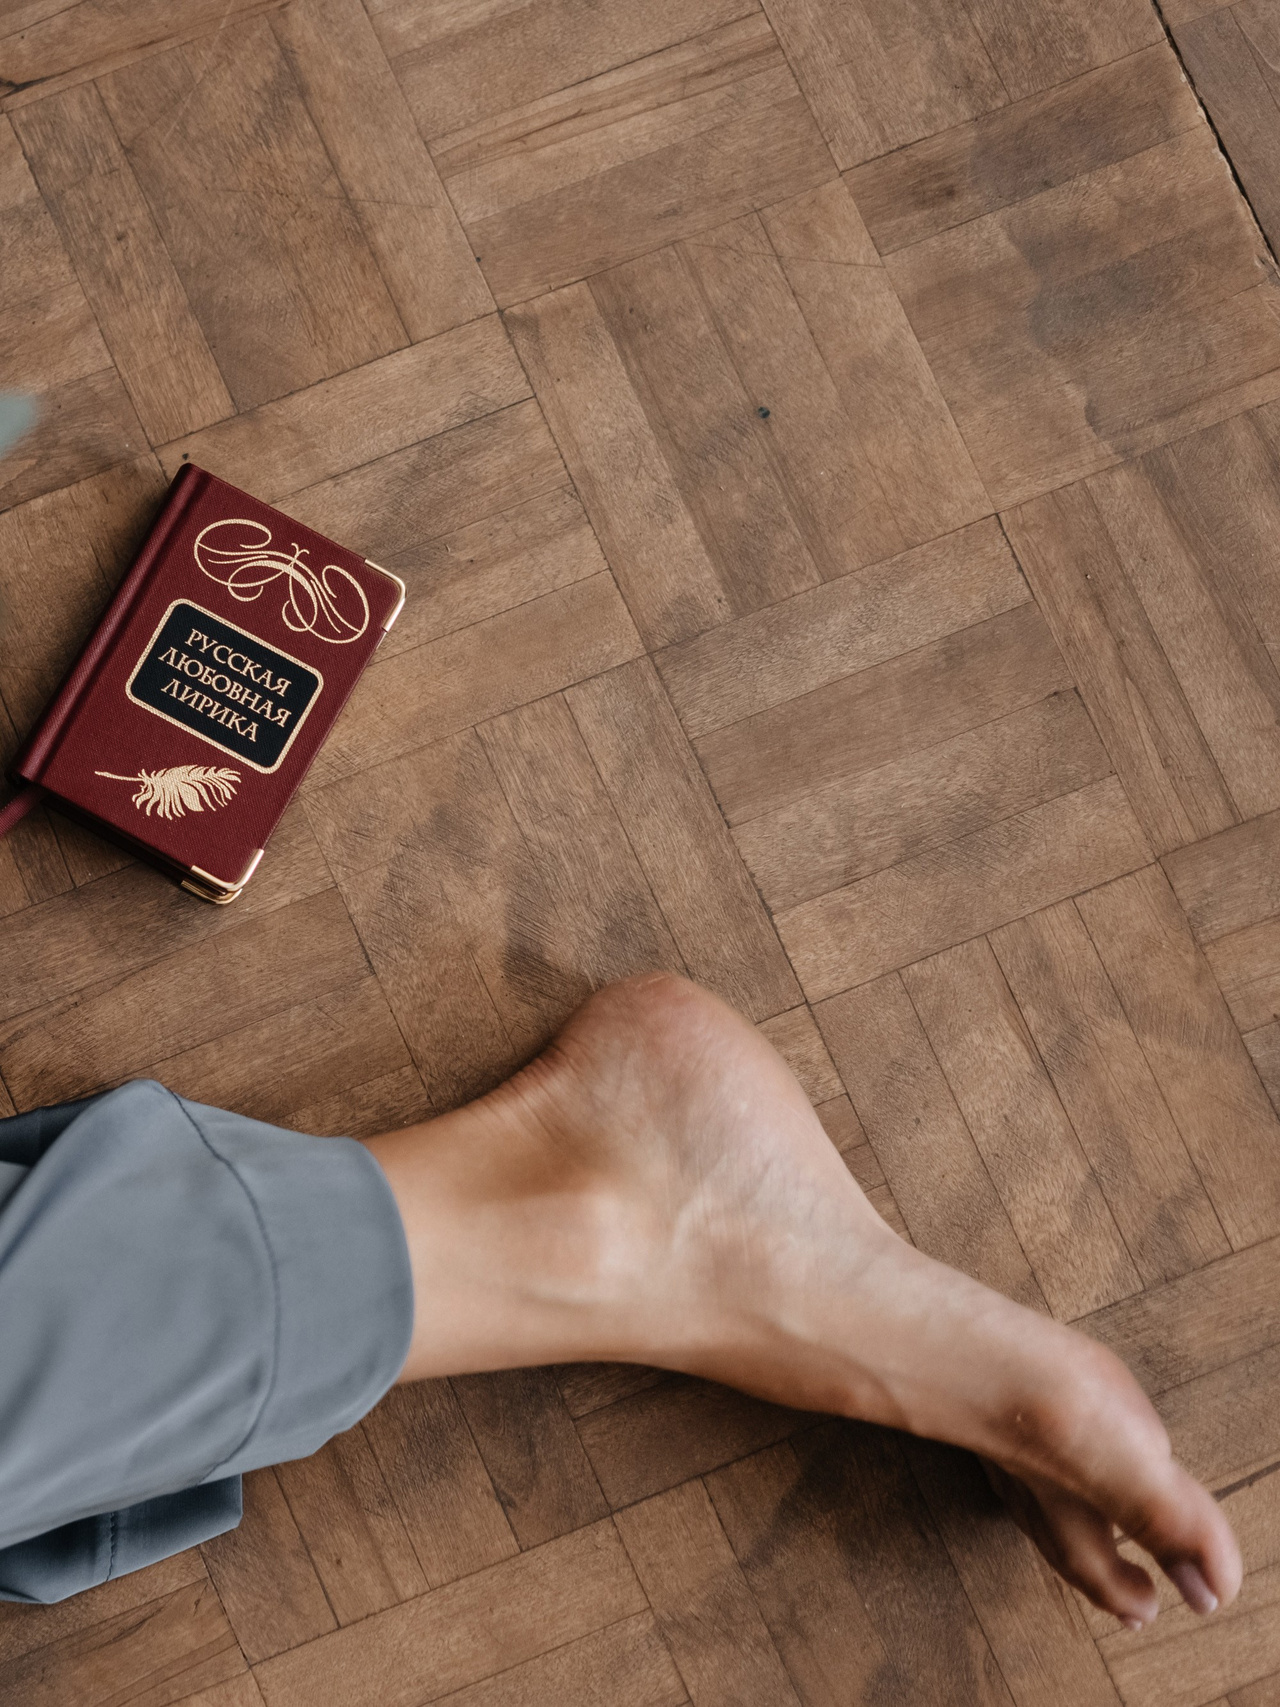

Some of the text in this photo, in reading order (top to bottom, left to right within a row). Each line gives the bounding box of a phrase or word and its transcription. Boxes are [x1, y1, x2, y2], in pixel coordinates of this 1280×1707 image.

[158, 646, 292, 728] ЛЮБОВНАЯ
[185, 628, 292, 697] РУССКАЯ
[160, 678, 259, 742] ЛИРИКА
